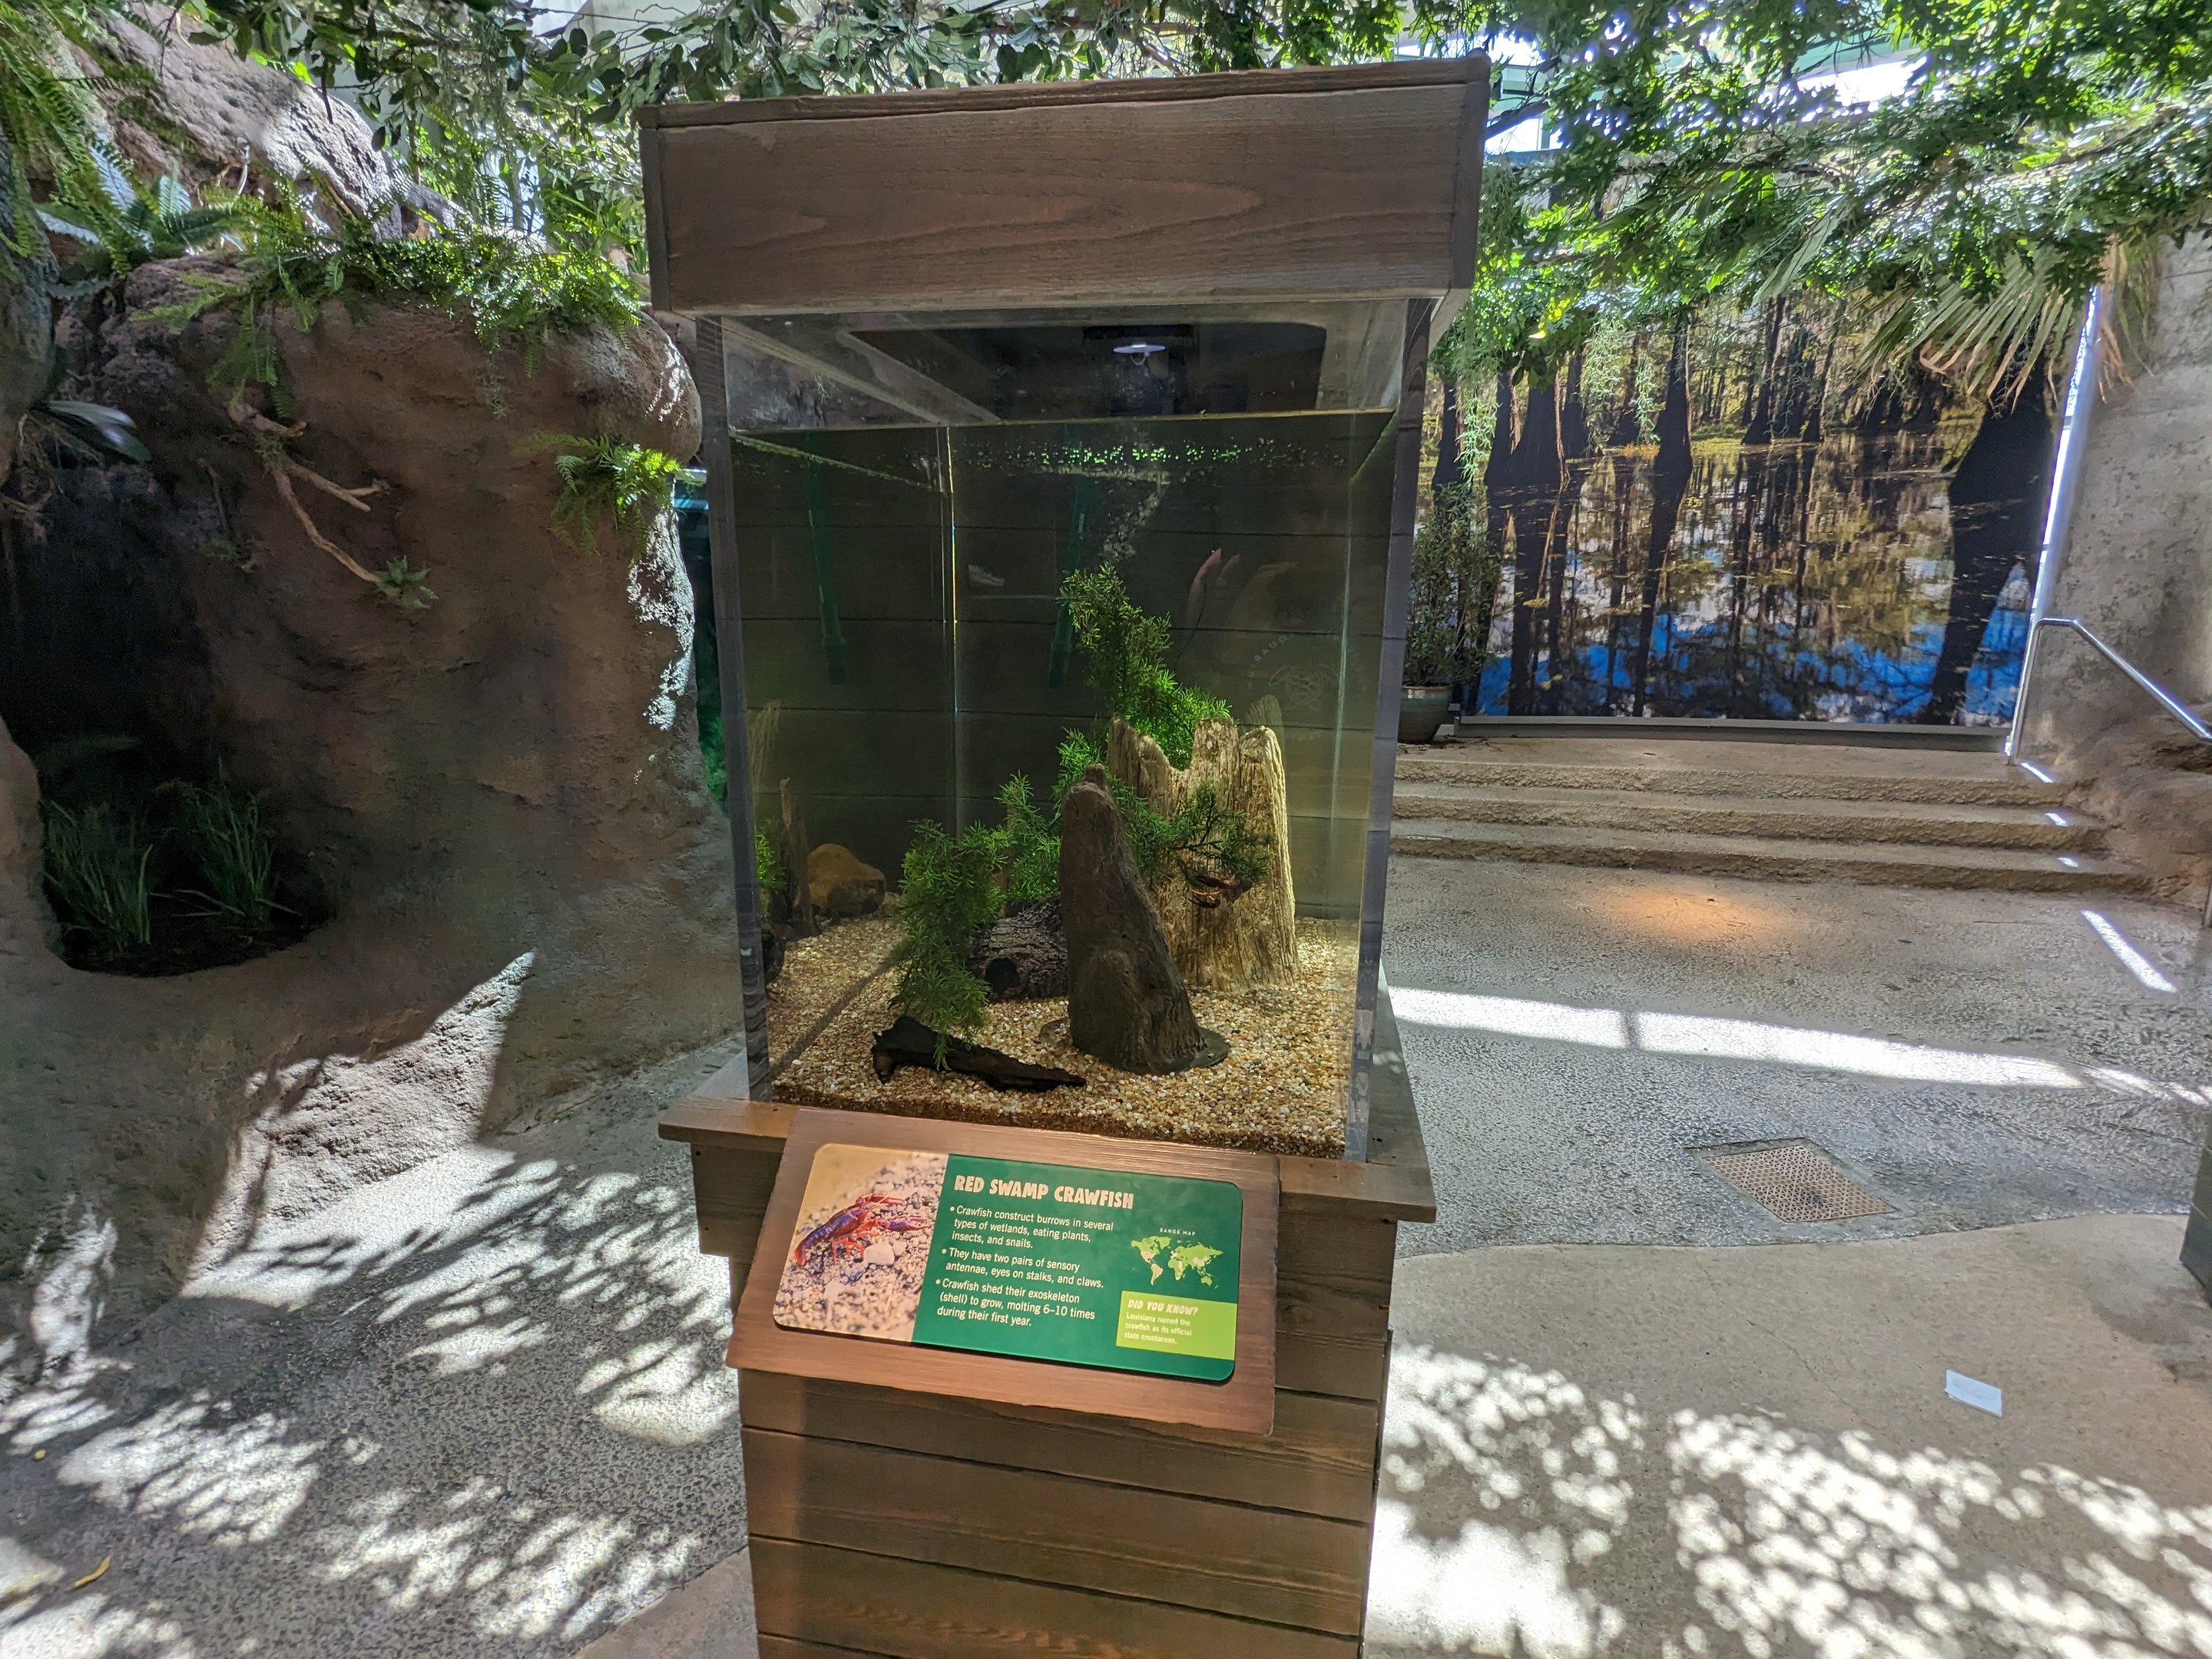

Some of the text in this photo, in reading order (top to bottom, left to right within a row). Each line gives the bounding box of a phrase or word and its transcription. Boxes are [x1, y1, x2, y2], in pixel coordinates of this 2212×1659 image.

[954, 1175, 1134, 1209] RED SWAMP CRAWFISH
[954, 1218, 1091, 1243] types of wetlands, eating plants,
[956, 1205, 1114, 1231] Crawfish construct burrows in several
[952, 1230, 1033, 1249] insects, and snails.
[949, 1247, 1080, 1273] They have two pairs of sensory
[945, 1262, 1104, 1288] antennae, eyes on stalks, and claws.
[942, 1278, 1080, 1303] Crawfish shed their exoskeleton
[937, 1306, 1031, 1326] during their first year.
[939, 1292, 968, 1304] (shell)
[970, 1296, 979, 1305] to
[981, 1299, 1004, 1310] grow,
[1006, 1301, 1041, 1315] molting
[1070, 1307, 1095, 1320] times
[1126, 1312, 1156, 1323] Louisiana
[1128, 1300, 1198, 1316] DID YOU KNOW?
[1124, 1323, 1151, 1331] crawfish
[1170, 1327, 1192, 1336] official
